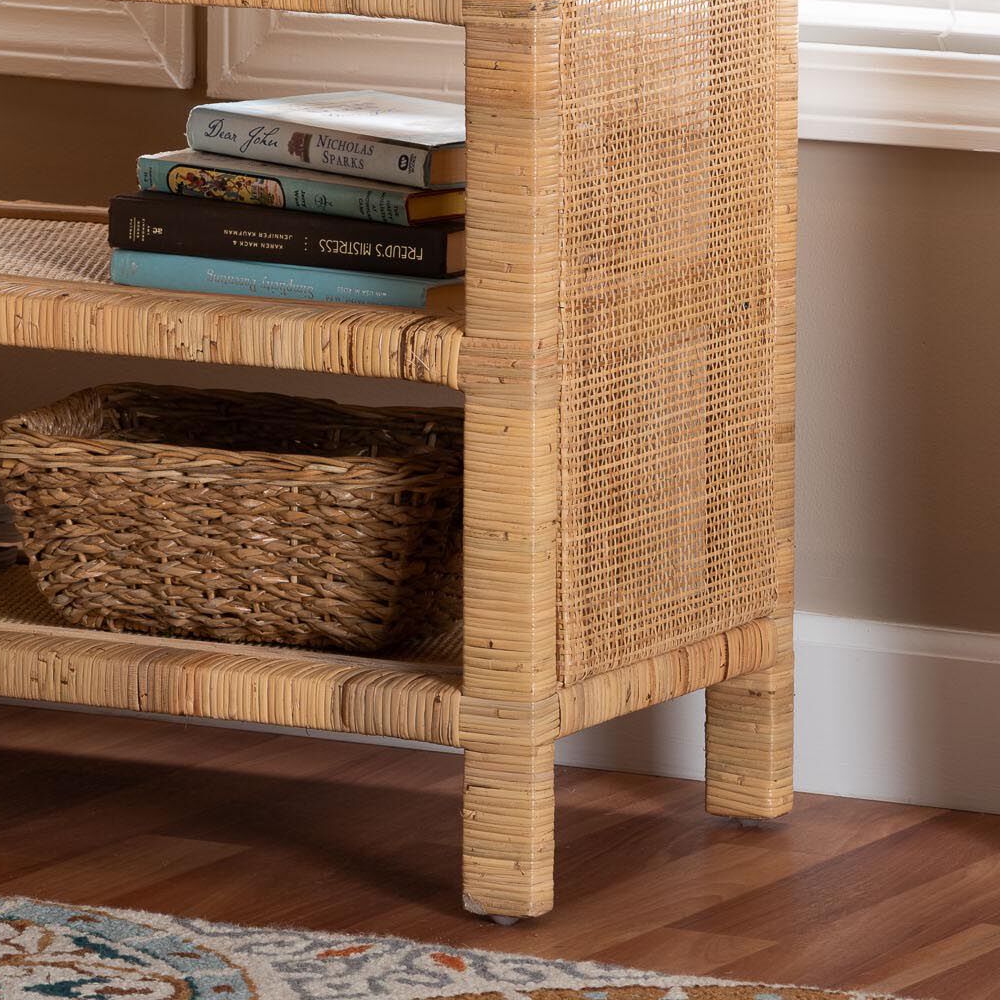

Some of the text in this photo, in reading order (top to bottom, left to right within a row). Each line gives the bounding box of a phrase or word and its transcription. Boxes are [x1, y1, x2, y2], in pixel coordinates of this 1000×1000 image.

[204, 118, 280, 153] Dear John
[316, 134, 376, 157] NICHOLAS
[322, 150, 365, 170] SPARKS
[257, 231, 292, 239] JENNIFER
[318, 238, 423, 260] FREUD'S MISTRESS
[206, 268, 256, 292] Parenting
[262, 276, 314, 298] Simplicity
